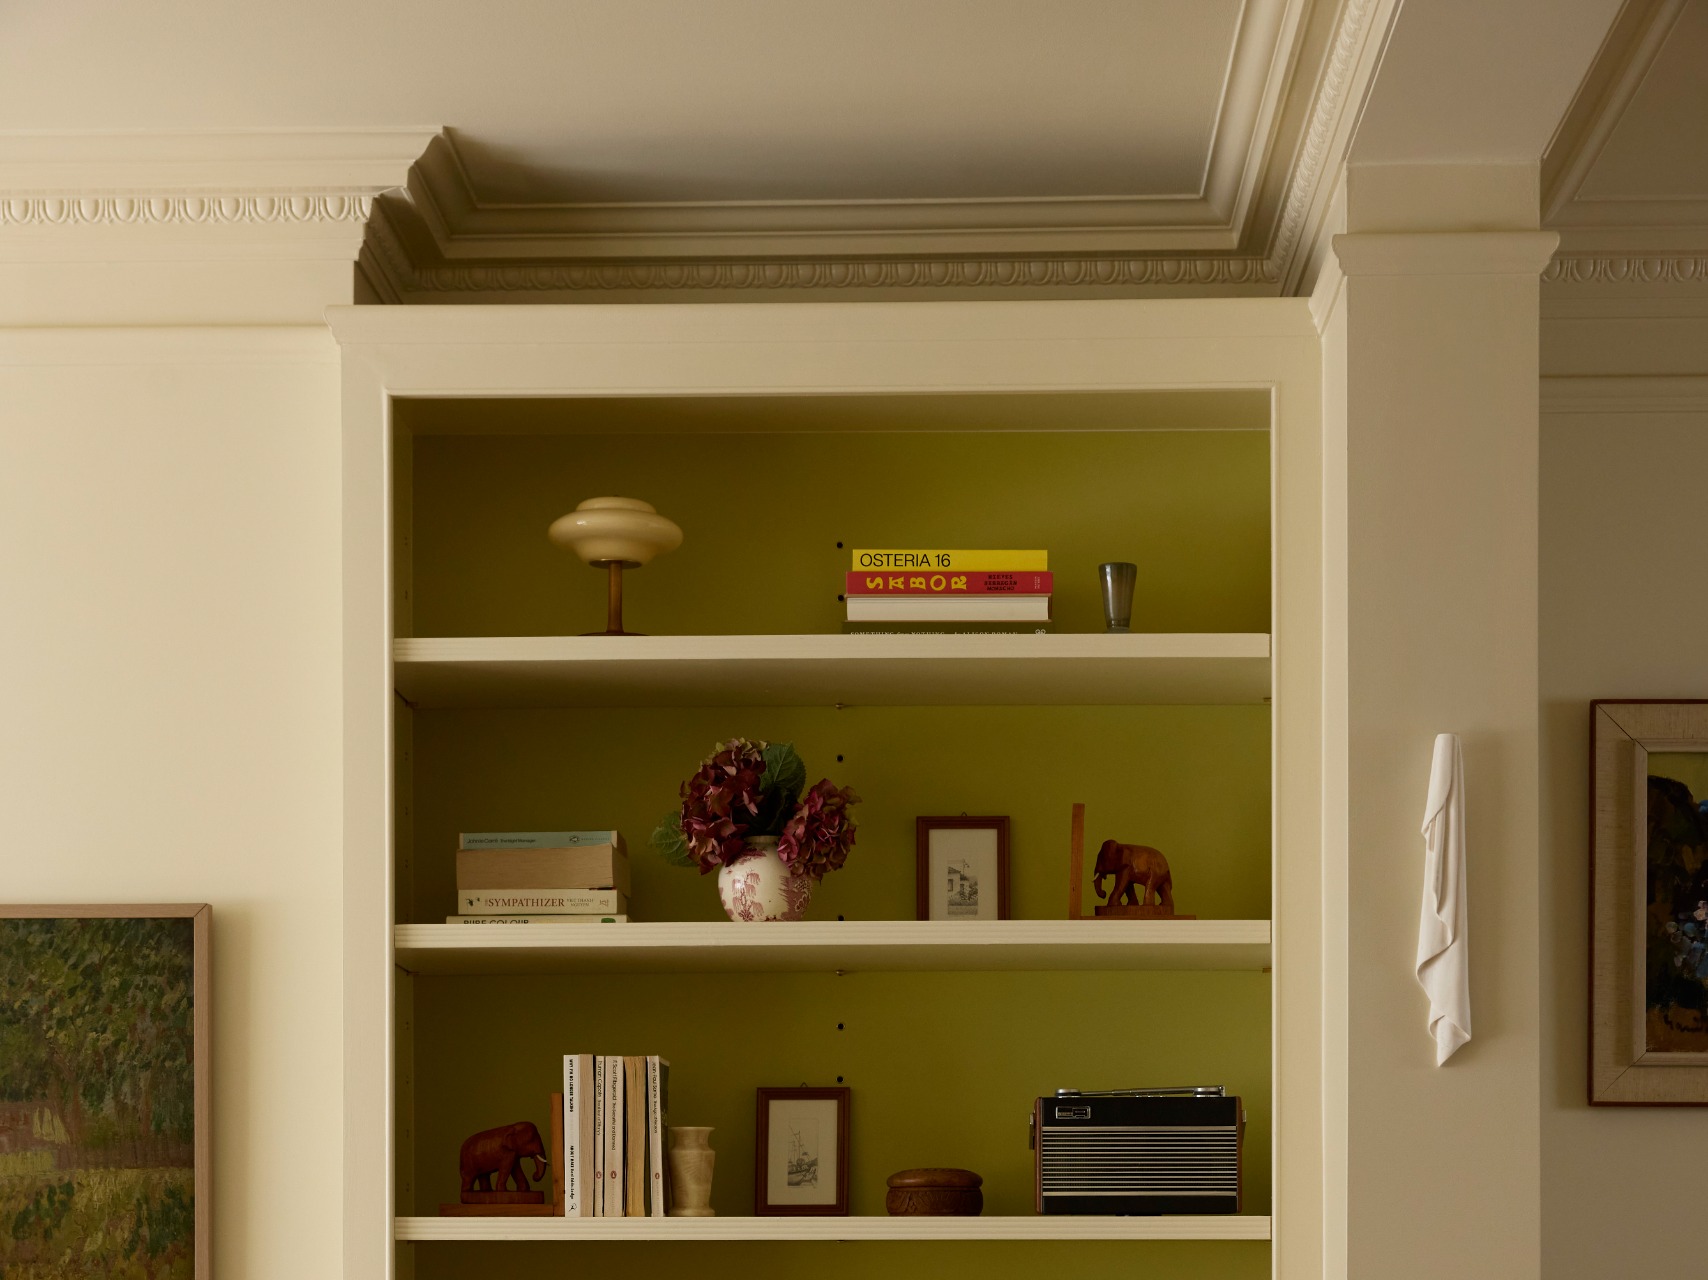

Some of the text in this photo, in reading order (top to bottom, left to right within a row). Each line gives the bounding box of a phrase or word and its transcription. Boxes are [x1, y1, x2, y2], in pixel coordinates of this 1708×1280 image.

[860, 553, 951, 567] OSTERIA 16
[866, 574, 967, 591] SABOR
[488, 898, 565, 907] SYMPATHIZER
